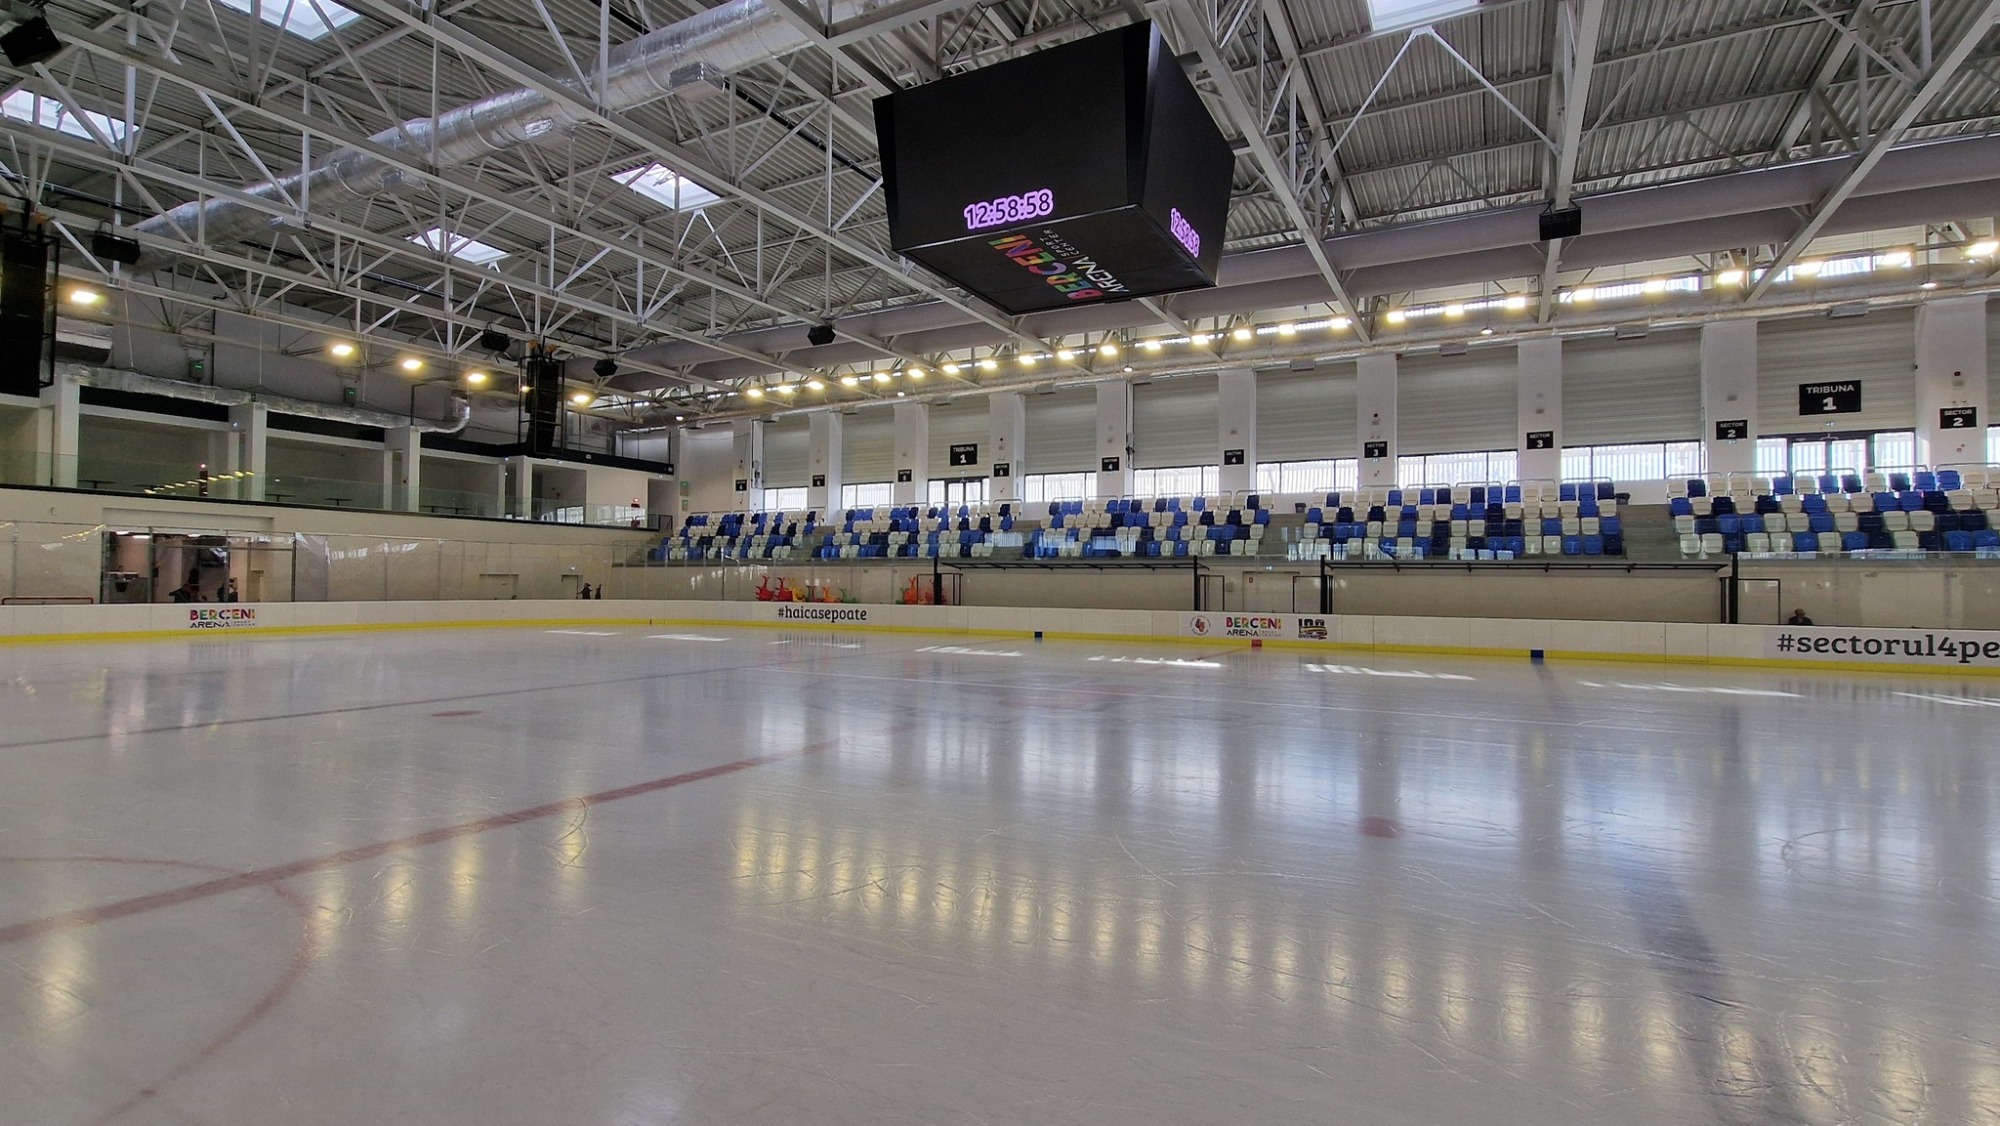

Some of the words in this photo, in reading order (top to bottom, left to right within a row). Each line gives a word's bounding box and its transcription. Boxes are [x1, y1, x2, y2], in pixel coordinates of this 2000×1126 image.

[964, 189, 1054, 229] 12:58:58
[988, 234, 1104, 300] BERCENI
[1072, 256, 1131, 293] ARENA
[1806, 385, 1855, 394] TRIBUNA
[1823, 397, 1837, 411] 1
[1953, 417, 1964, 427] 2
[1727, 429, 1736, 438] 2
[1536, 440, 1543, 448] 3
[960, 454, 967, 463] 1
[1373, 449, 1379, 457] 3
[190, 609, 256, 620] BERCENI
[778, 605, 867, 623] #haicasepoate
[1226, 617, 1282, 630] BERCENI
[1226, 629, 1259, 637] ARENA
[1777, 634, 2000, 663] #sectorul4pe
